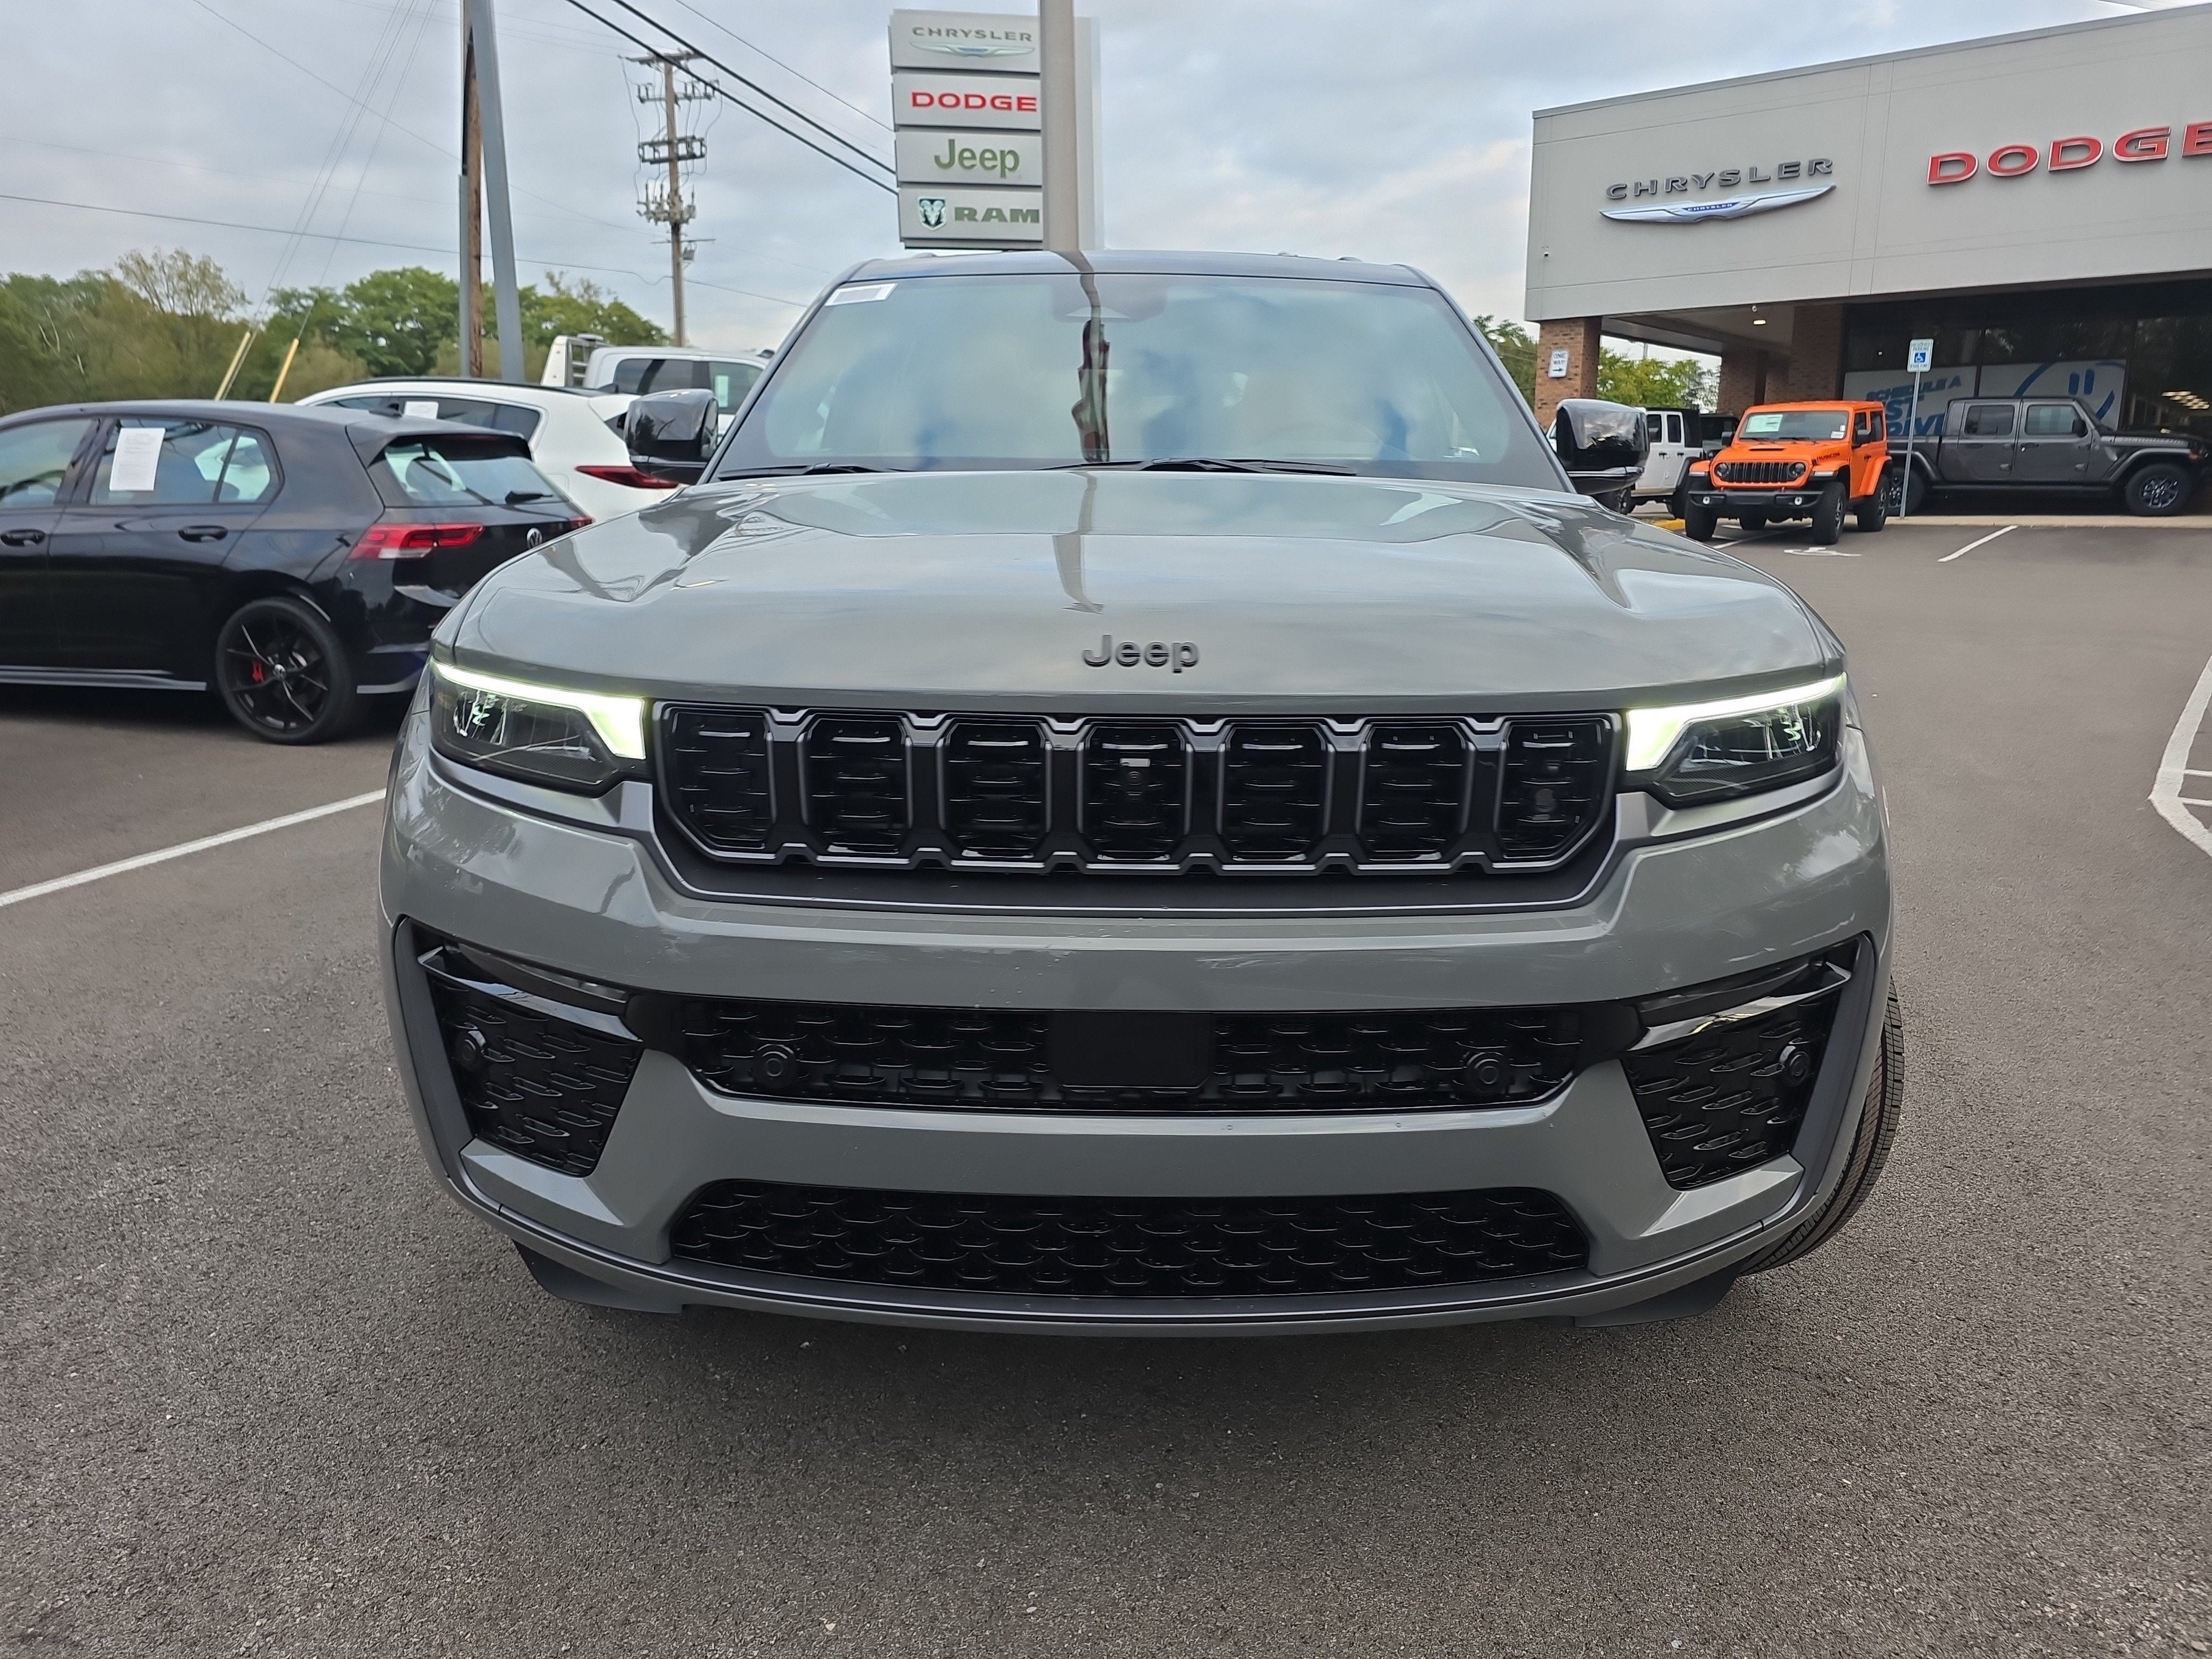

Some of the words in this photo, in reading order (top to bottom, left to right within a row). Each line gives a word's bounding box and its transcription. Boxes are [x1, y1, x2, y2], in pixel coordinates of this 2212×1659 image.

[912, 26, 1033, 42] CHRYSLER
[911, 92, 1037, 112] DODGE
[934, 139, 1020, 178] Jeep
[1605, 157, 1833, 200] CHRYSLER
[954, 206, 1040, 224] RAM
[1082, 634, 1199, 673] Jeep
